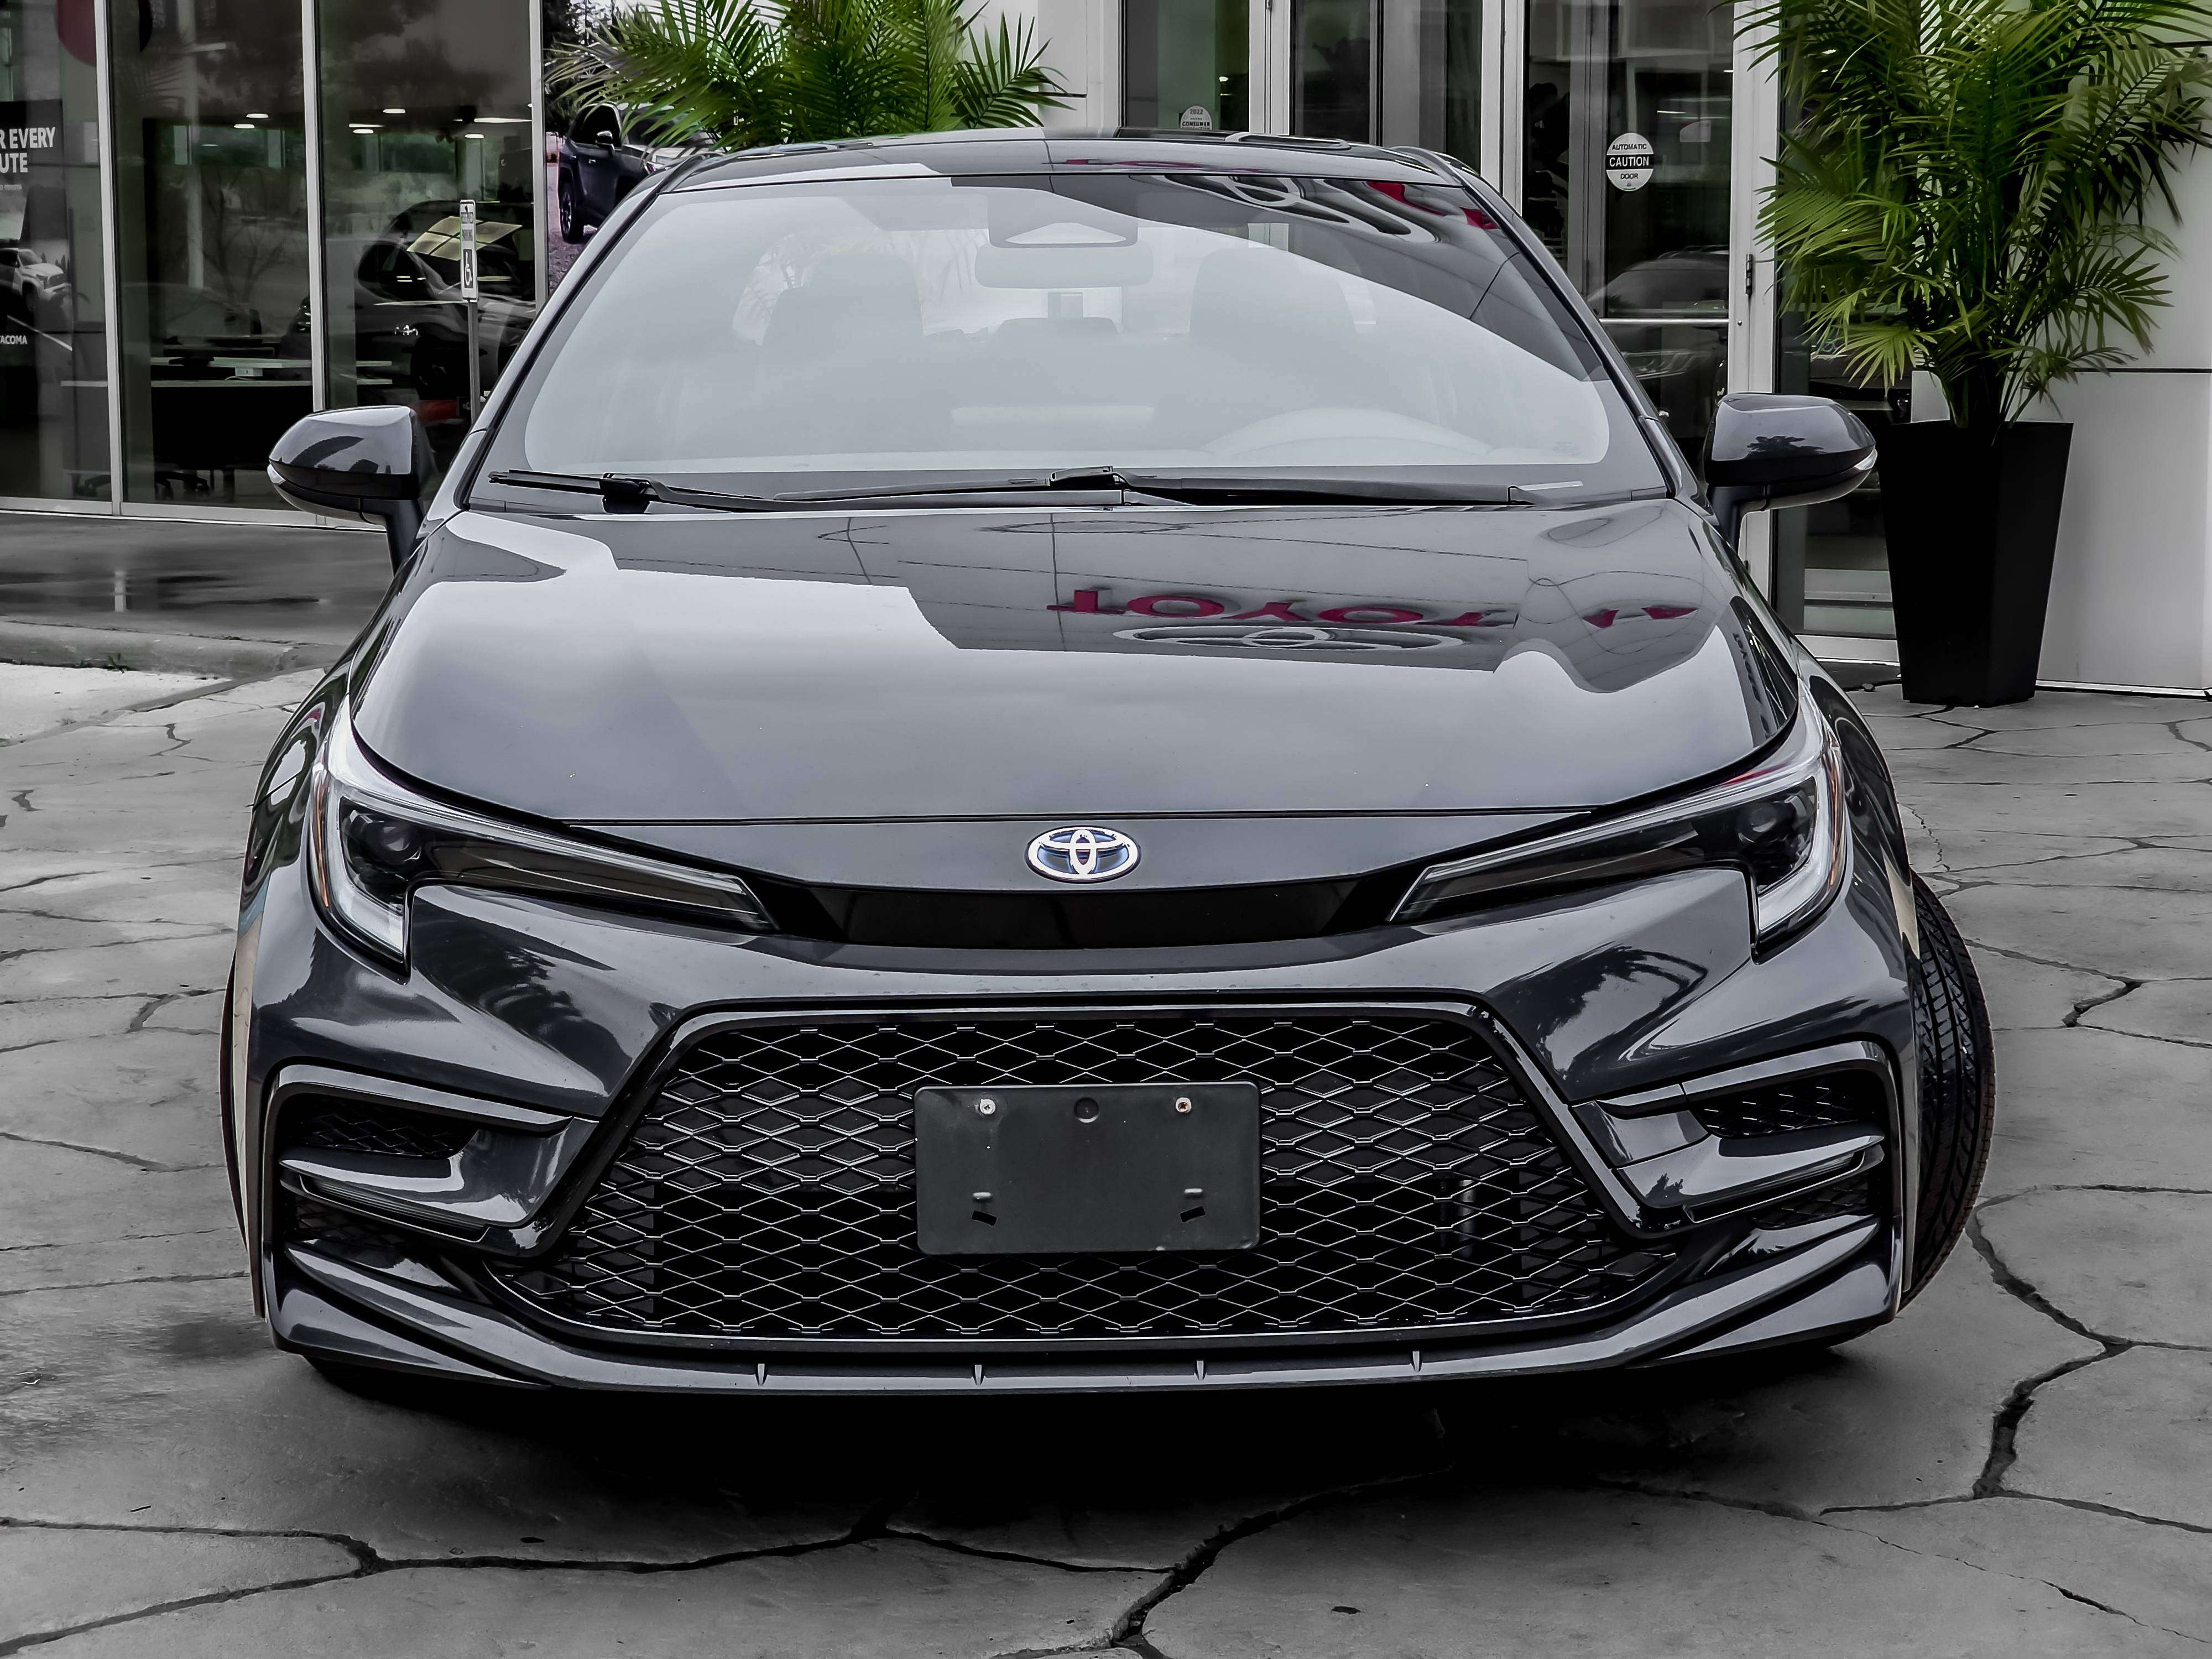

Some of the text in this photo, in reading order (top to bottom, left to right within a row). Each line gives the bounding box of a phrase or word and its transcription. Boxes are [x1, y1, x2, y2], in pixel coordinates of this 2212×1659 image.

[9, 127, 56, 149] EVERY
[1609, 156, 1649, 167] CAUTION
[0, 335, 28, 345] ACOMA
